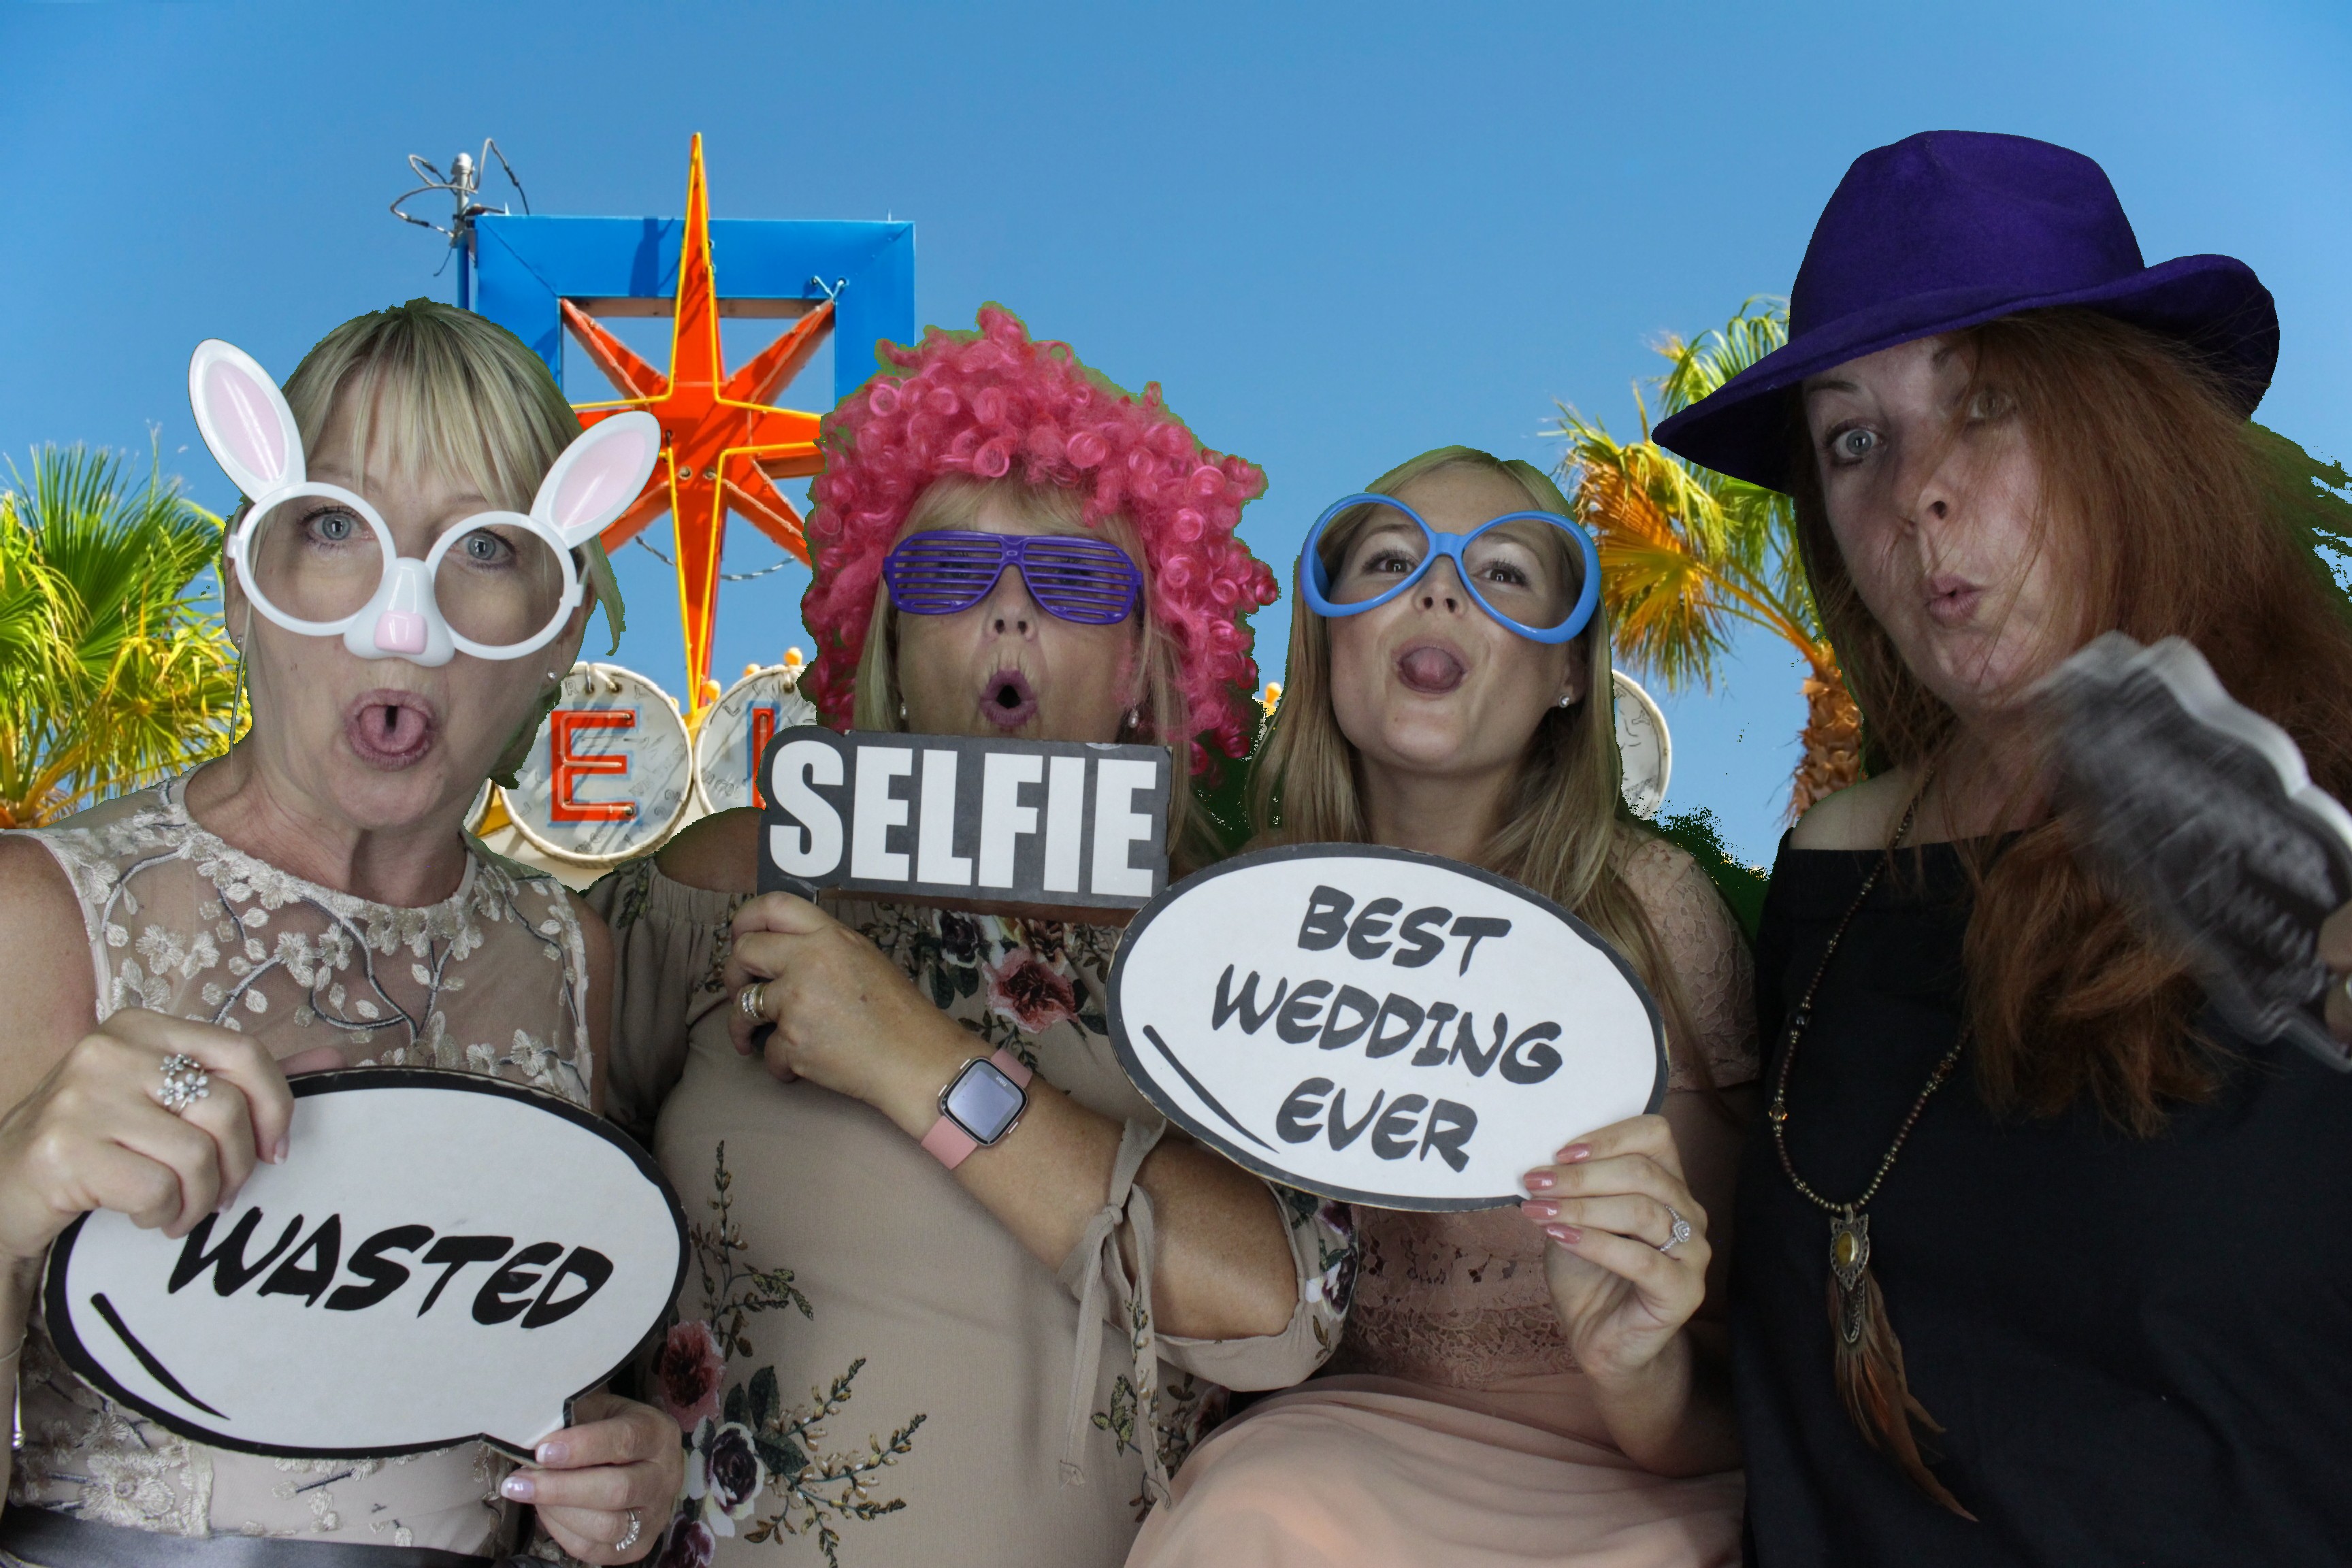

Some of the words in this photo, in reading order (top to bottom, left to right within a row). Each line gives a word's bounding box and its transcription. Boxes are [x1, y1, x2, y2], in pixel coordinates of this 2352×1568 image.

[770, 740, 1157, 898] SELFIE
[1298, 885, 1512, 977] BEST
[1211, 964, 1563, 1085] WEDDING
[996, 1075, 1007, 1087] fitbit
[1276, 1077, 1478, 1173] EVER
[168, 1206, 614, 1329] WASTED
